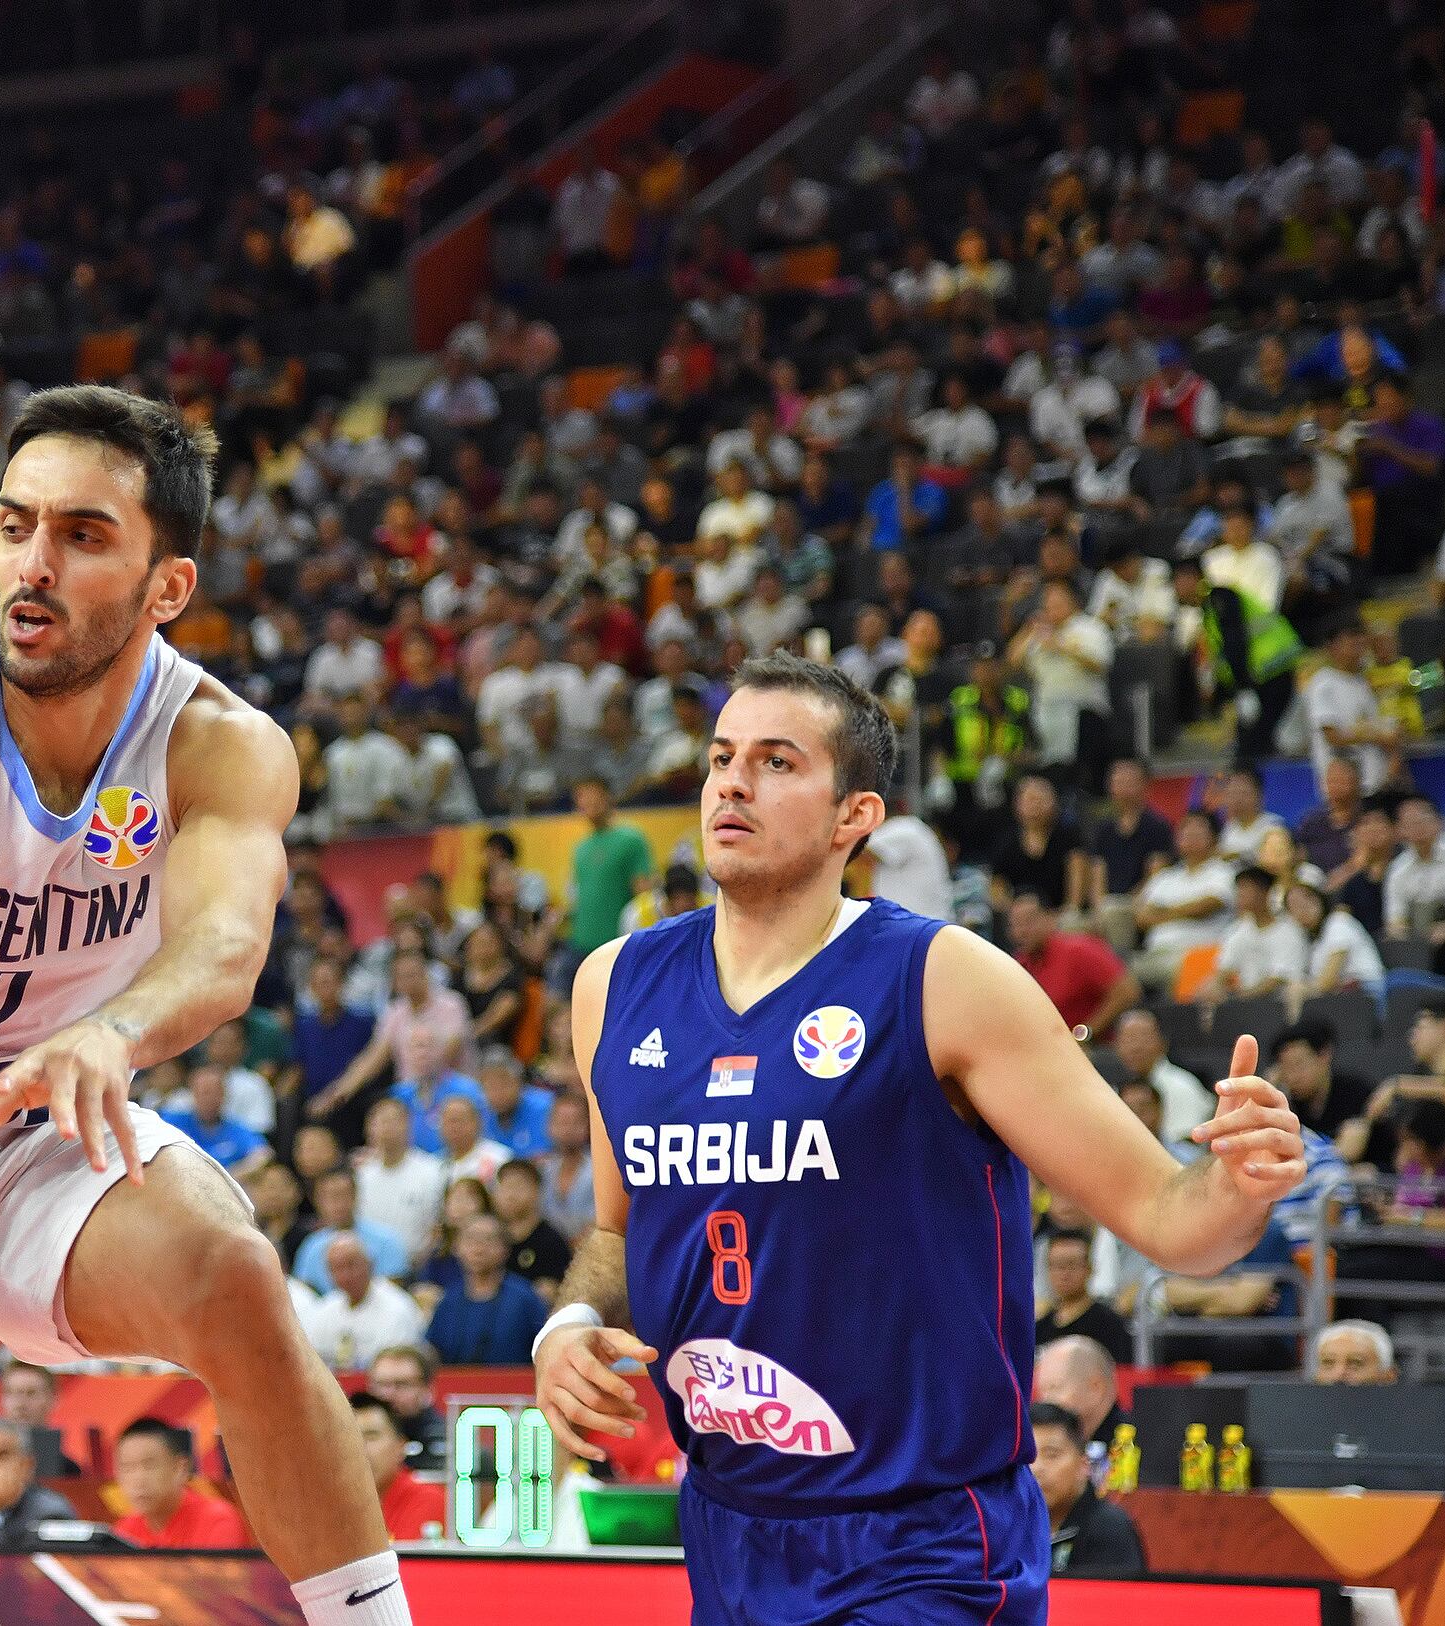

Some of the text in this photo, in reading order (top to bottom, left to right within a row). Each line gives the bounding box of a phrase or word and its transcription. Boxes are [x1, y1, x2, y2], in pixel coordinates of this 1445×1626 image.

[629, 1047, 669, 1068] PEAK
[624, 1119, 840, 1186] SRBIJA
[706, 1210, 752, 1305] 8
